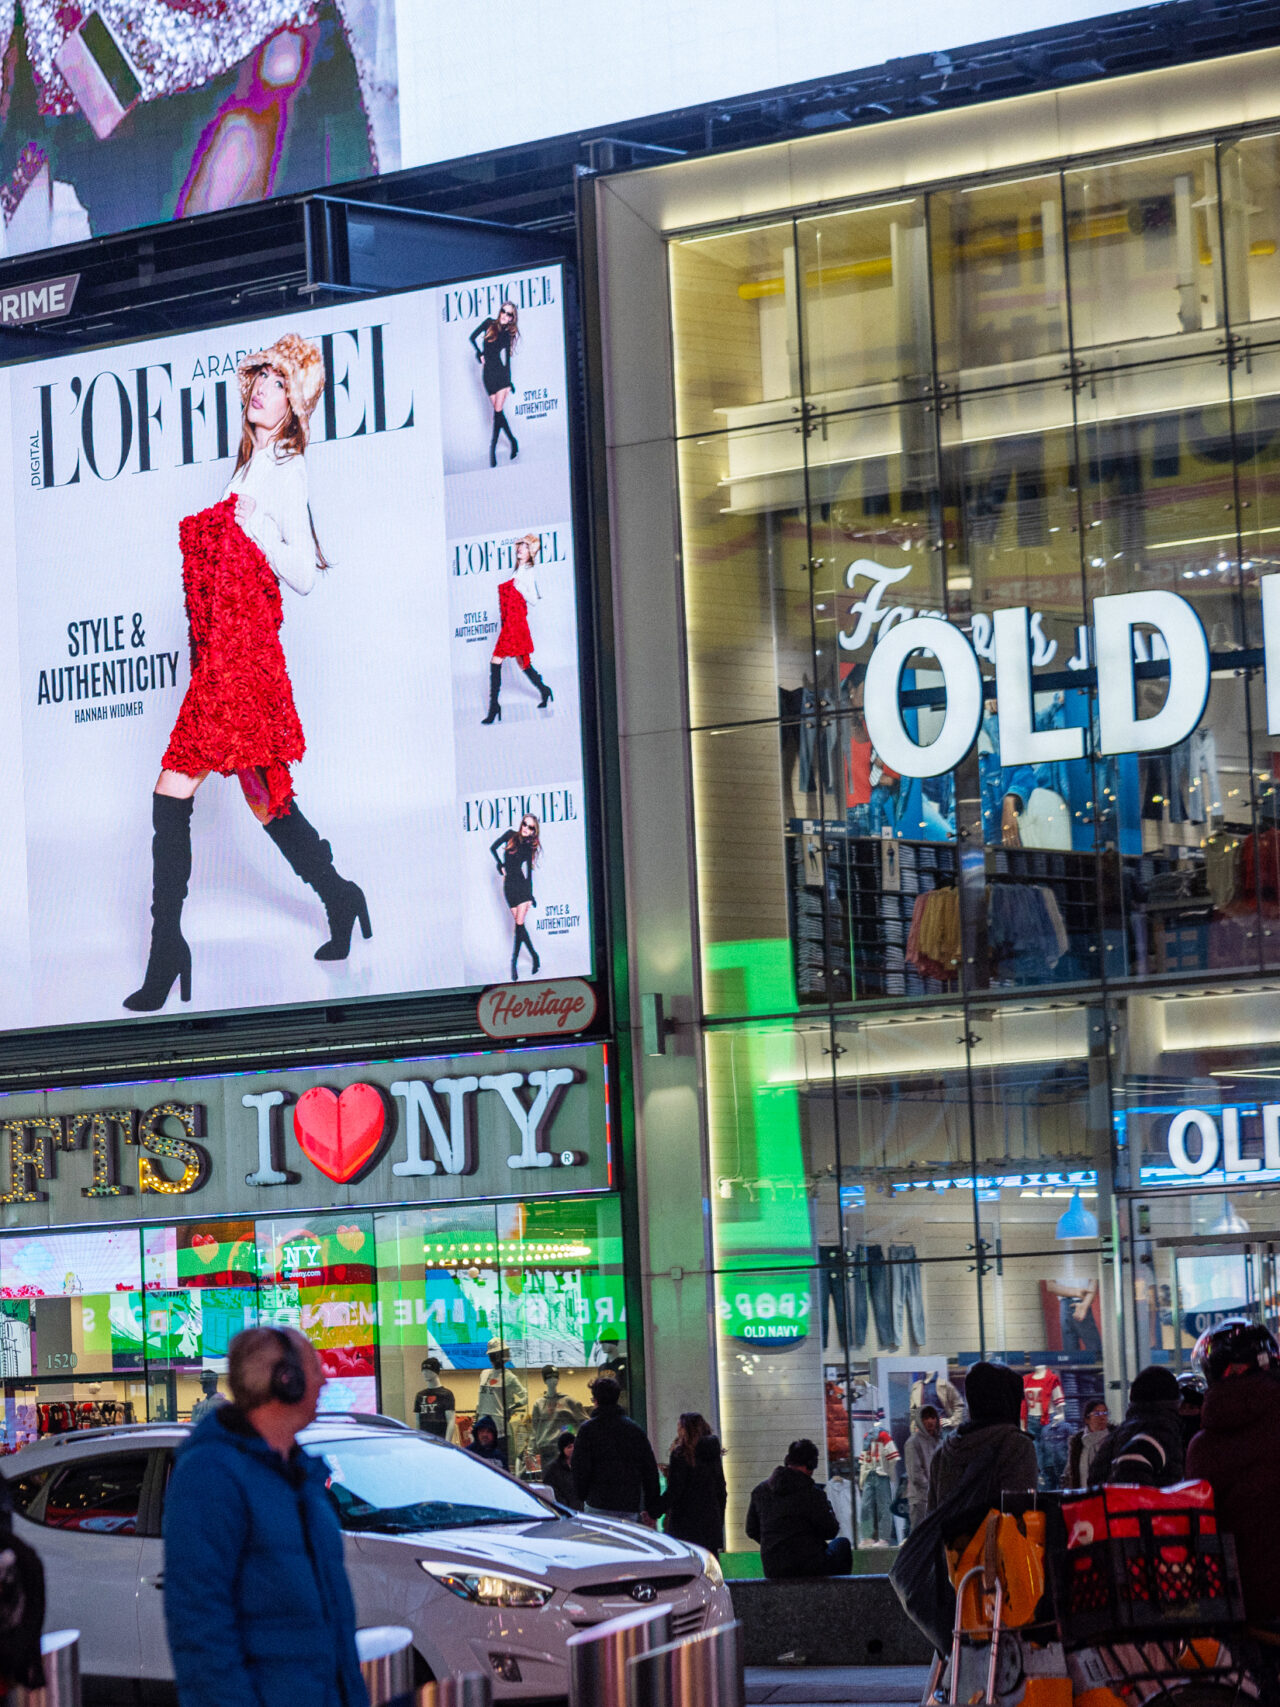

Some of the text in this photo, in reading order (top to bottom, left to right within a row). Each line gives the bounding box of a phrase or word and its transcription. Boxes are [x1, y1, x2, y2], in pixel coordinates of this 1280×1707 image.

[33, 323, 414, 490] L'OFFIEL
[31, 429, 41, 487] DIGITAL
[456, 531, 566, 576] L'OFFIEL
[67, 612, 146, 657] STYLE &
[37, 651, 179, 706] AUTHENTICITY
[864, 590, 1210, 778] OLD
[74, 701, 144, 724] HANNAH WIDMER
[489, 988, 586, 1028] Heritage
[242, 1091, 287, 1186] I
[744, 1325, 798, 1338] OLD NAVY
[46, 1352, 78, 1369] 1520
